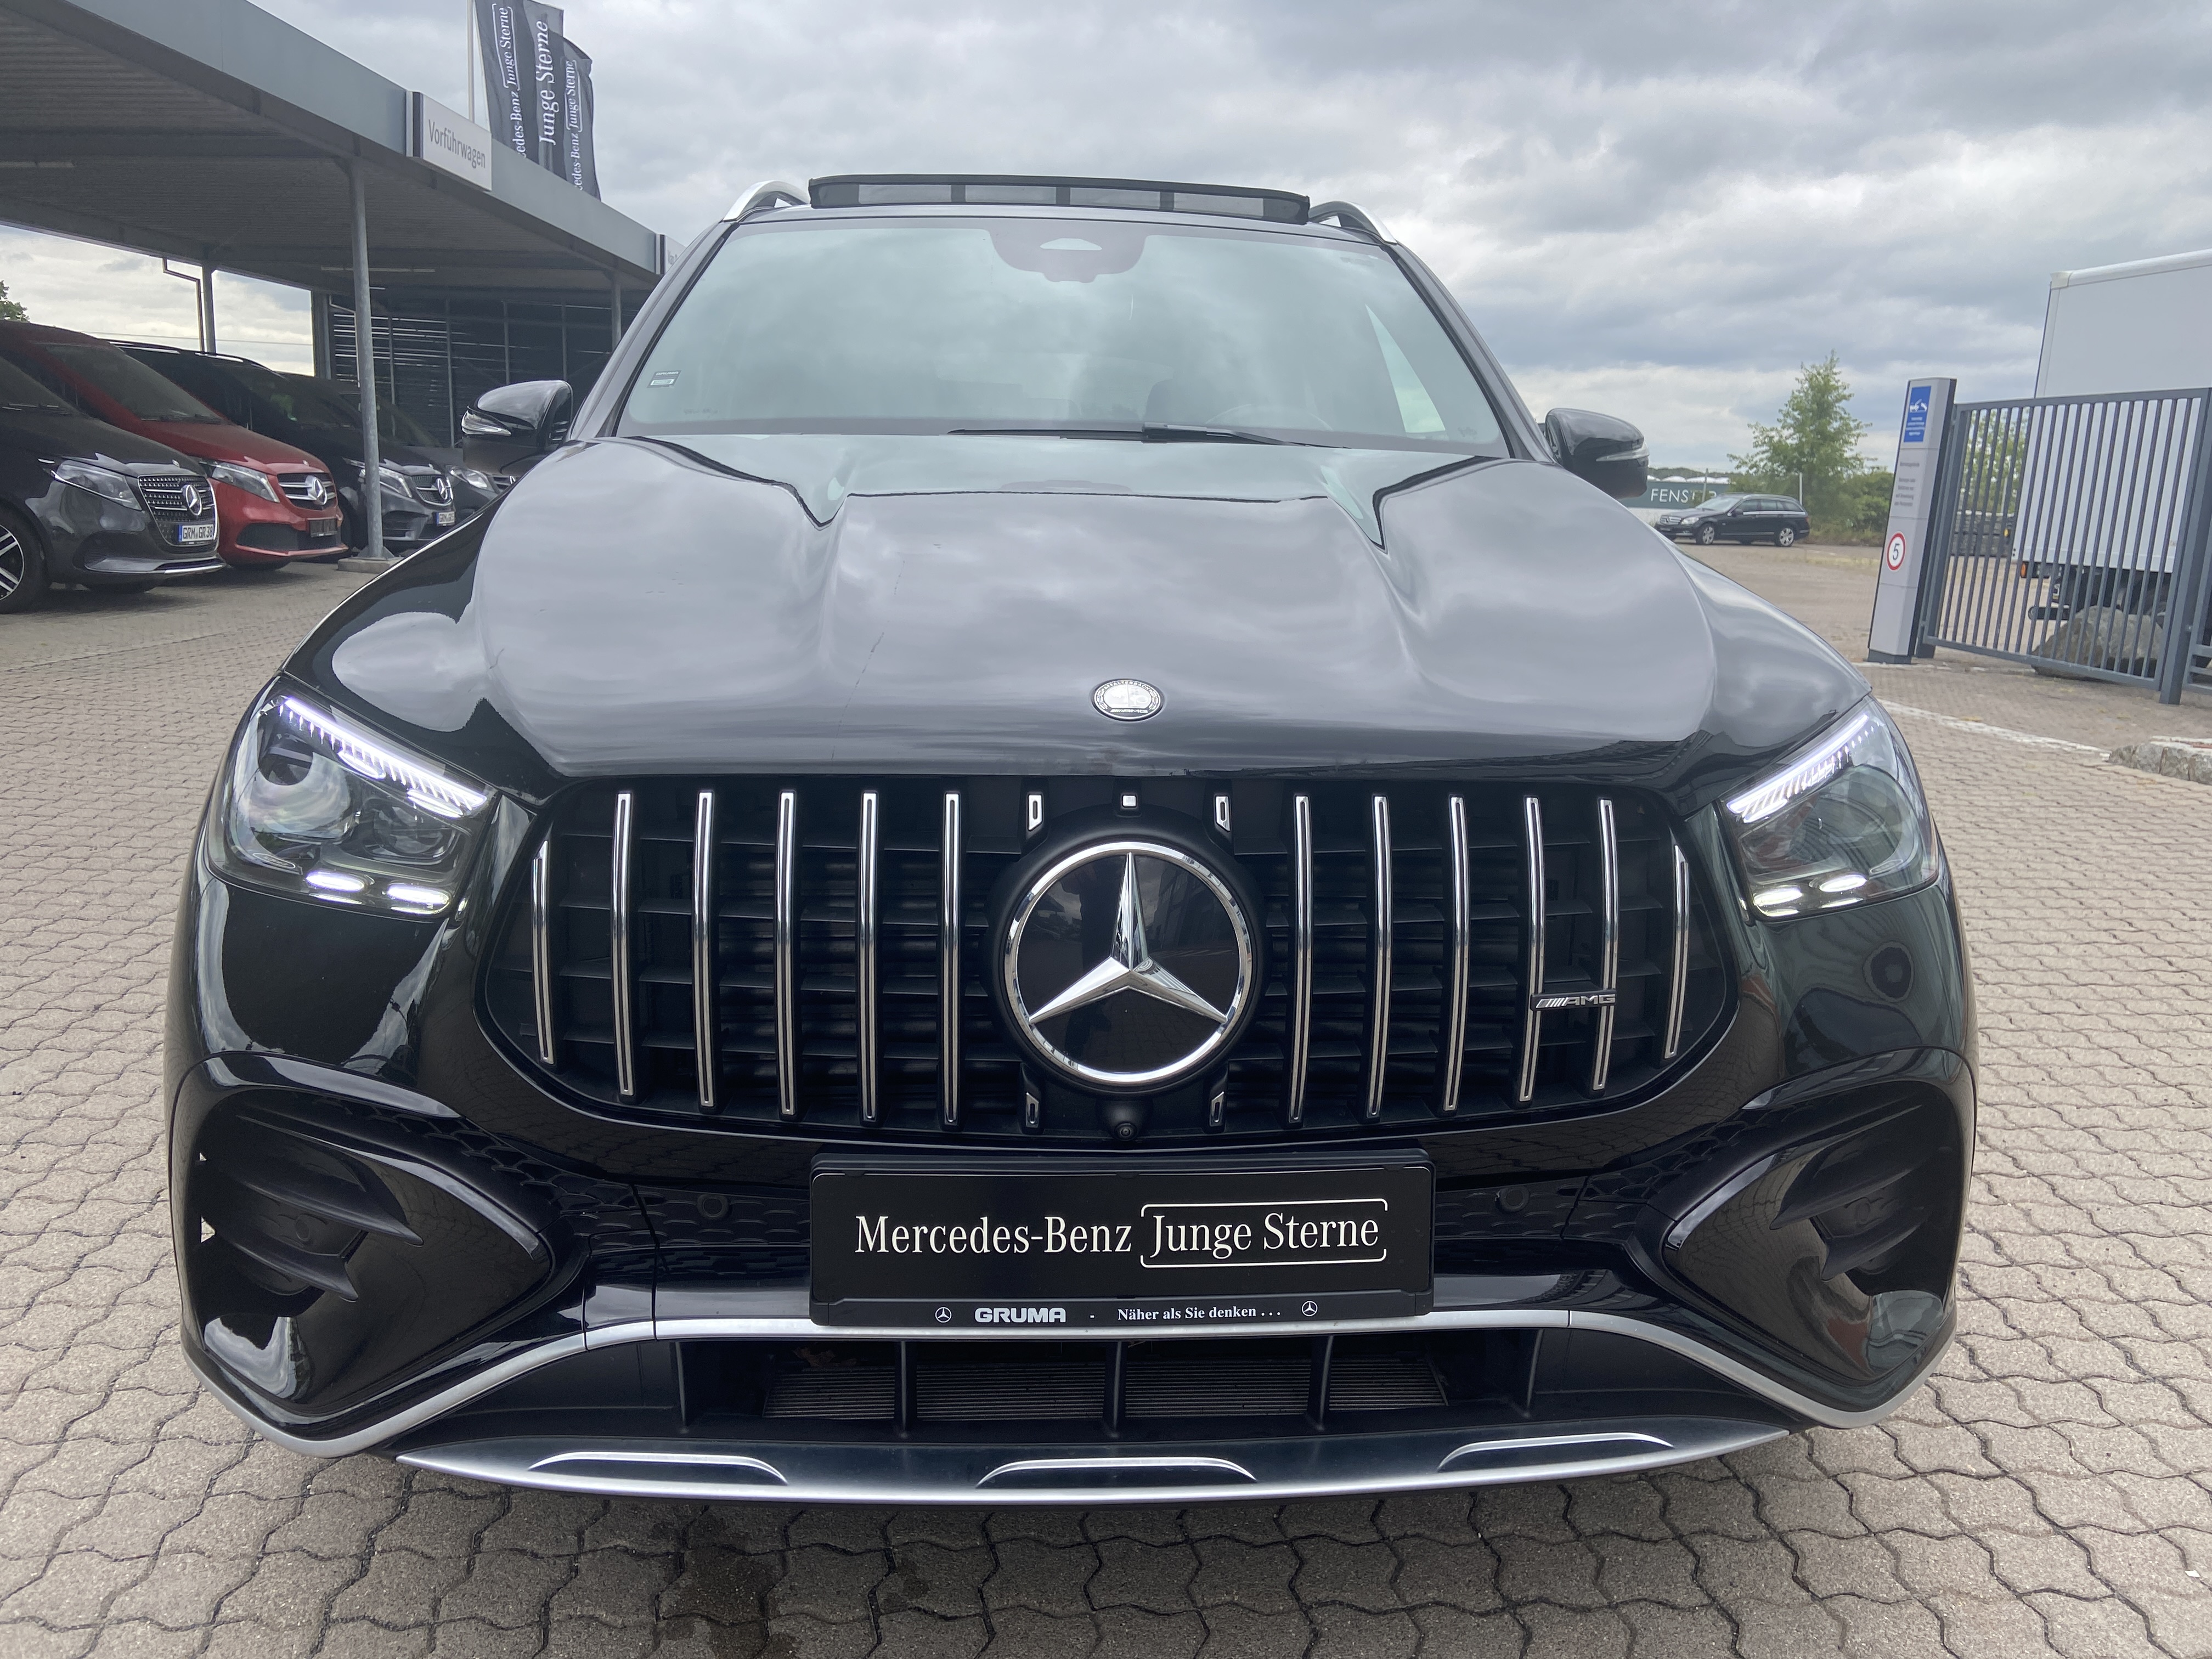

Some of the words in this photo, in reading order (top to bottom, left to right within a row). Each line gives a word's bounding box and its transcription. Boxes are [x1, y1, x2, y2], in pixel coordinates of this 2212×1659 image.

[499, 8, 511, 49] Sterne
[504, 52, 517, 86] Junge
[535, 21, 555, 84] Sterne
[565, 60, 575, 96] Sterne
[539, 90, 560, 145] Junge
[569, 98, 579, 129] Junge
[428, 119, 486, 169] Vorführwagen
[183, 527, 195, 539] GRM
[1893, 543, 1900, 560] 5
[1561, 994, 1616, 1006] AMG
[855, 1216, 1132, 1253] Mercedes-Benz
[1150, 1215, 1251, 1259] Junge
[1263, 1212, 1379, 1250] Sterne
[975, 1307, 1066, 1323] GRUMA
[1118, 1308, 1159, 1320] Näher
[1163, 1308, 1181, 1319] als
[1185, 1307, 1205, 1318] Sie
[1209, 1306, 1256, 1318] denken
